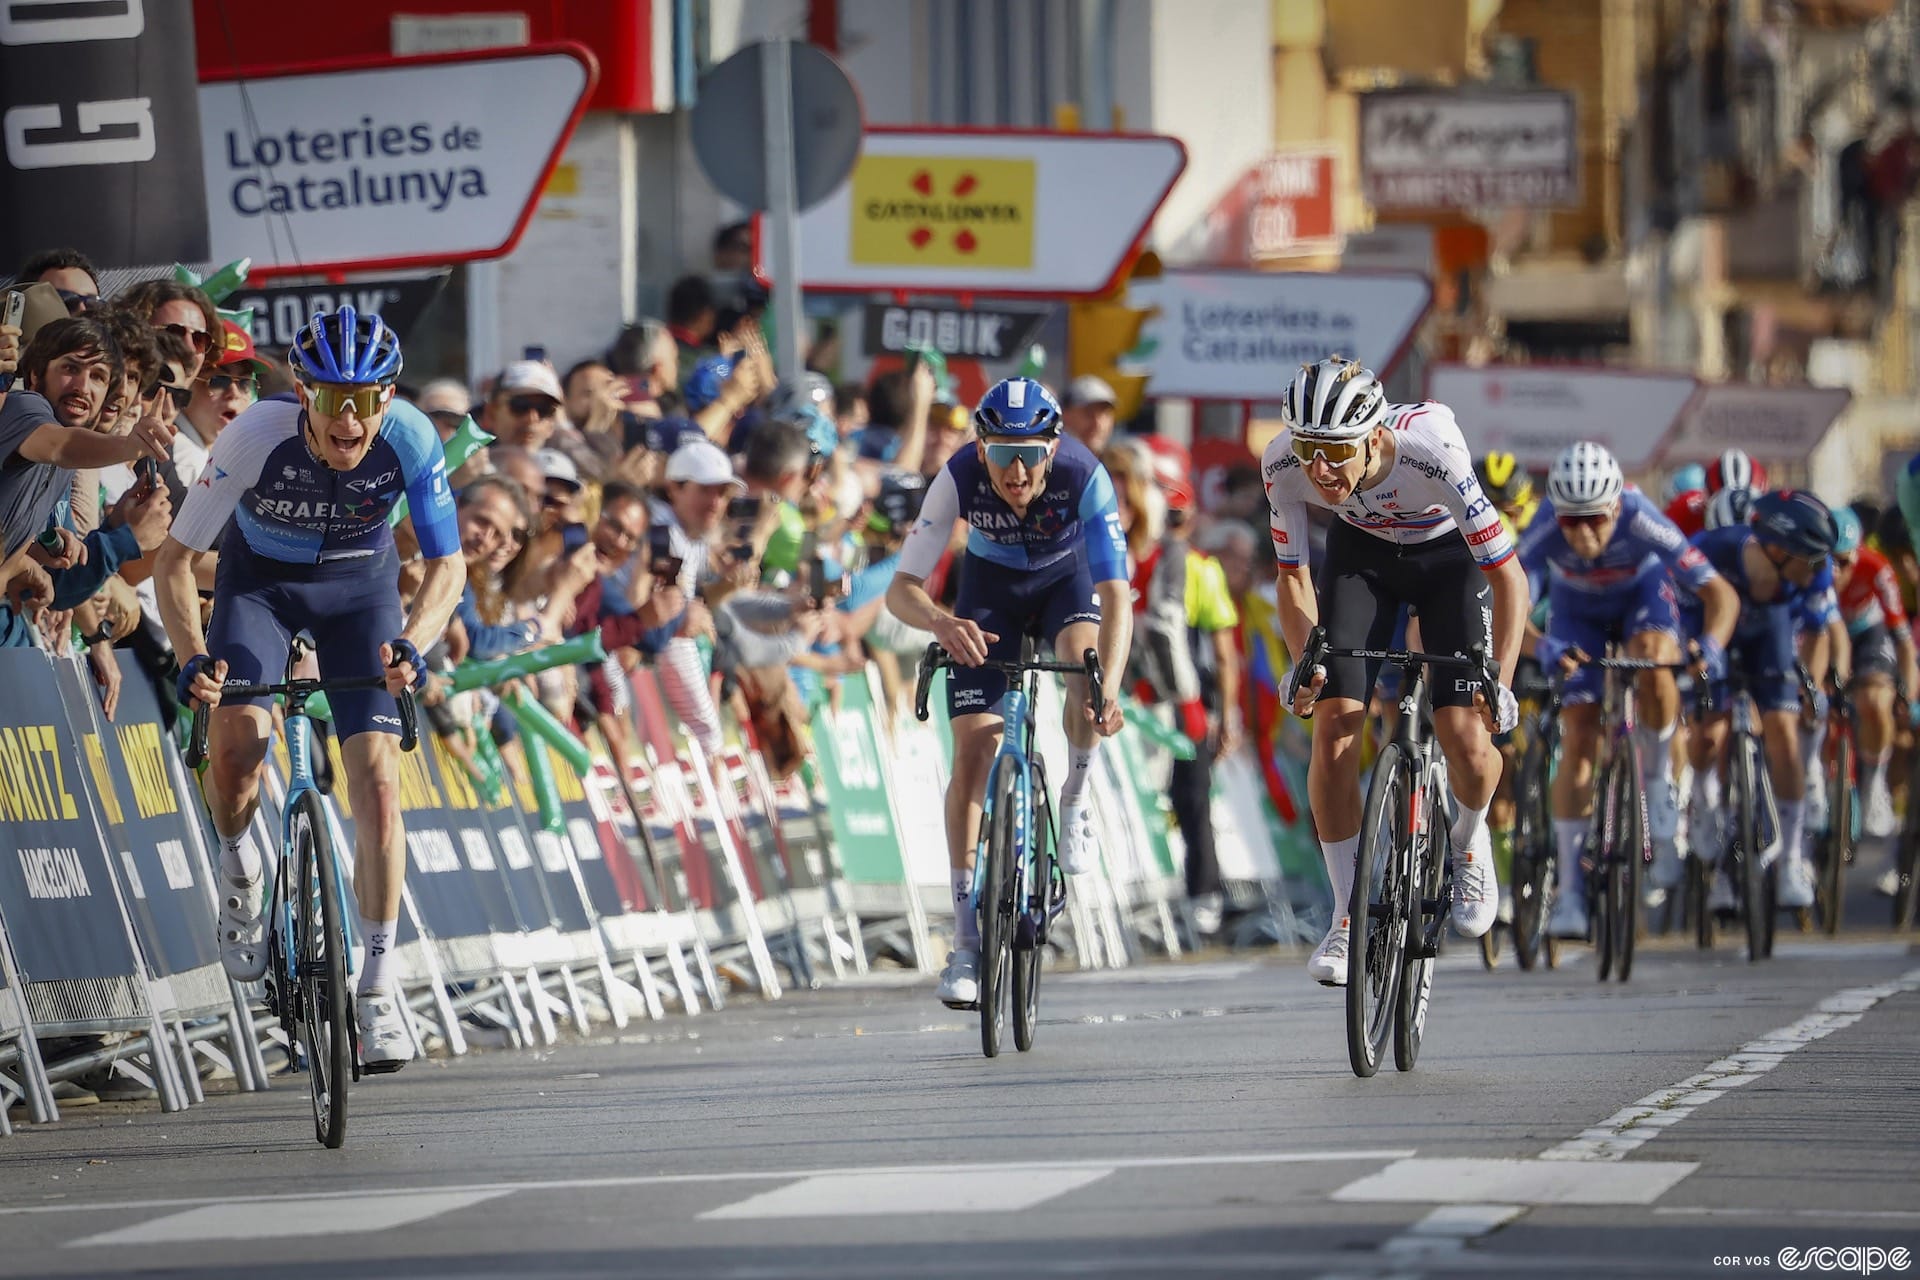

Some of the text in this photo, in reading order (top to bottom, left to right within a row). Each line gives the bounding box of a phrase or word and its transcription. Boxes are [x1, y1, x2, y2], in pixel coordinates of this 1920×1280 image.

[224, 115, 482, 171] Loteries de
[230, 165, 489, 218] Catalunya
[881, 307, 1002, 357] GOBIK
[1264, 454, 1300, 479] presig
[1400, 454, 1449, 482] presight
[224, 679, 251, 687] ACING
